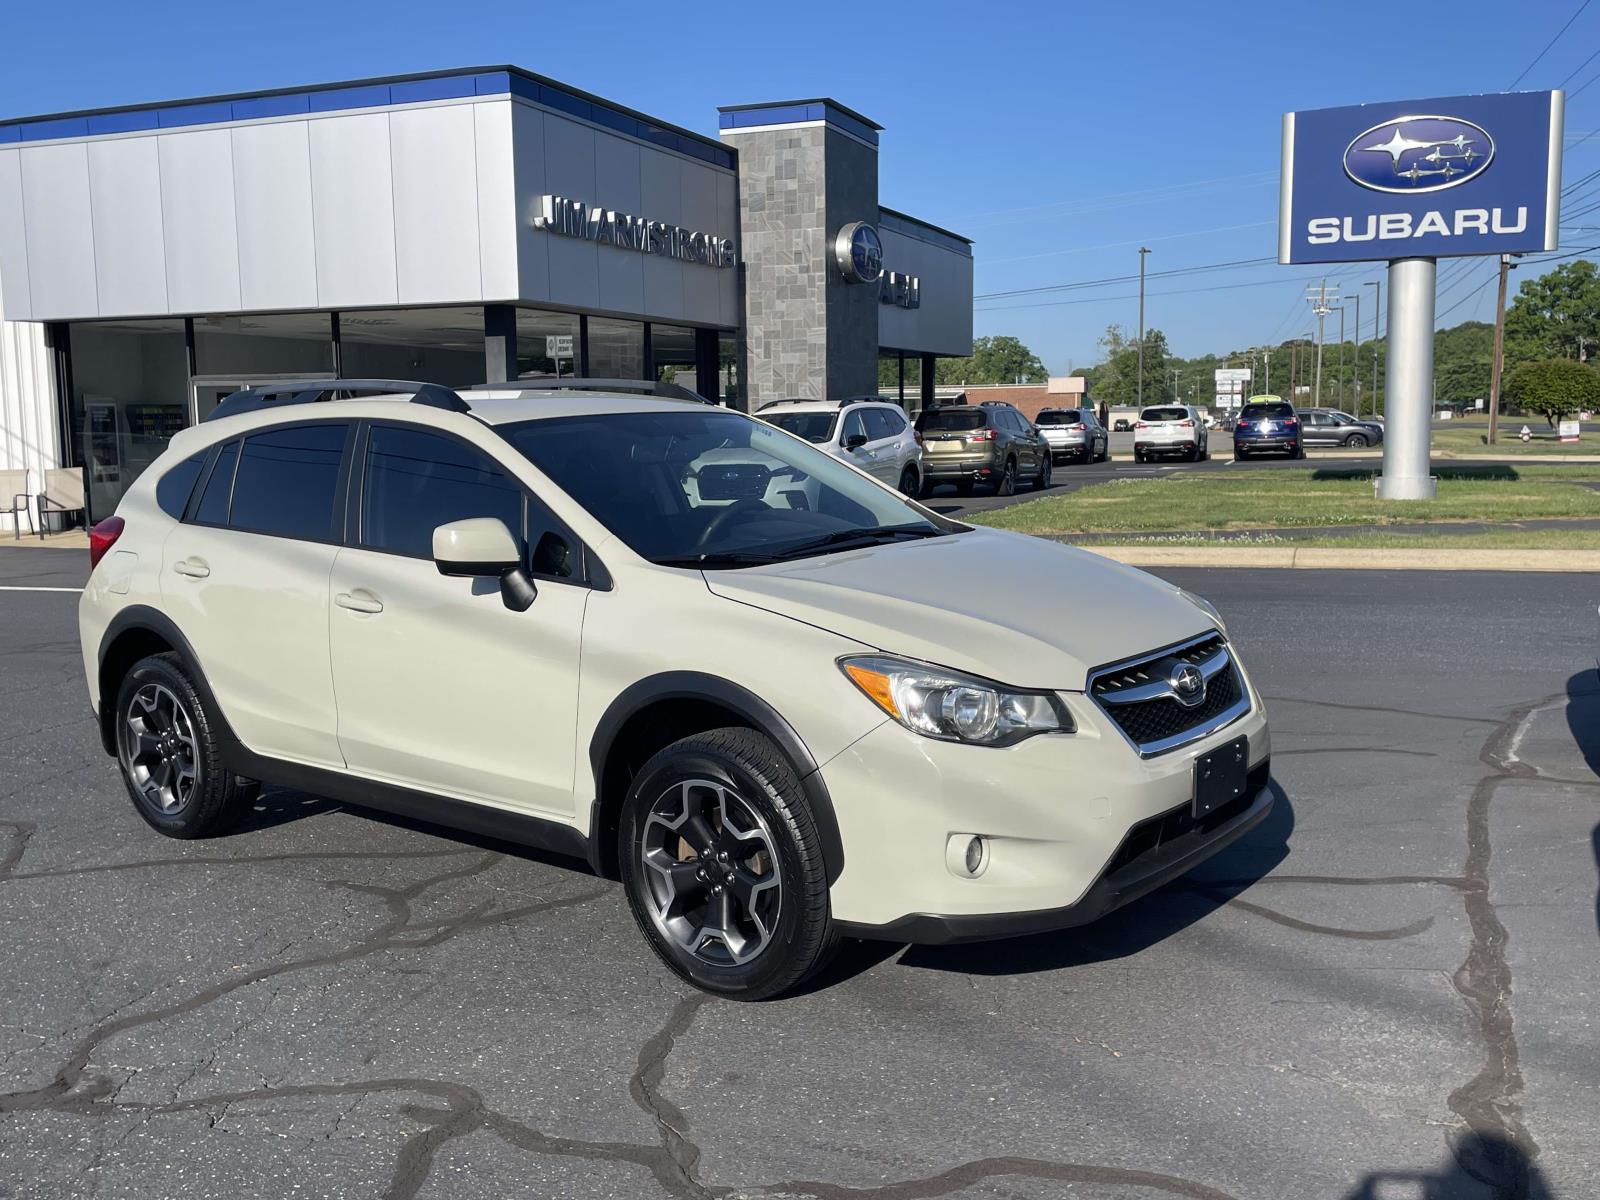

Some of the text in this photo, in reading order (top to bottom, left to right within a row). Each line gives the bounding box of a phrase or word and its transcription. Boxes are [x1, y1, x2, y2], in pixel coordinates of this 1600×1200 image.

[533, 194, 737, 269] JIM ARMSTRONG
[1307, 206, 1528, 245] SUBARU
[878, 268, 921, 310] ARU
